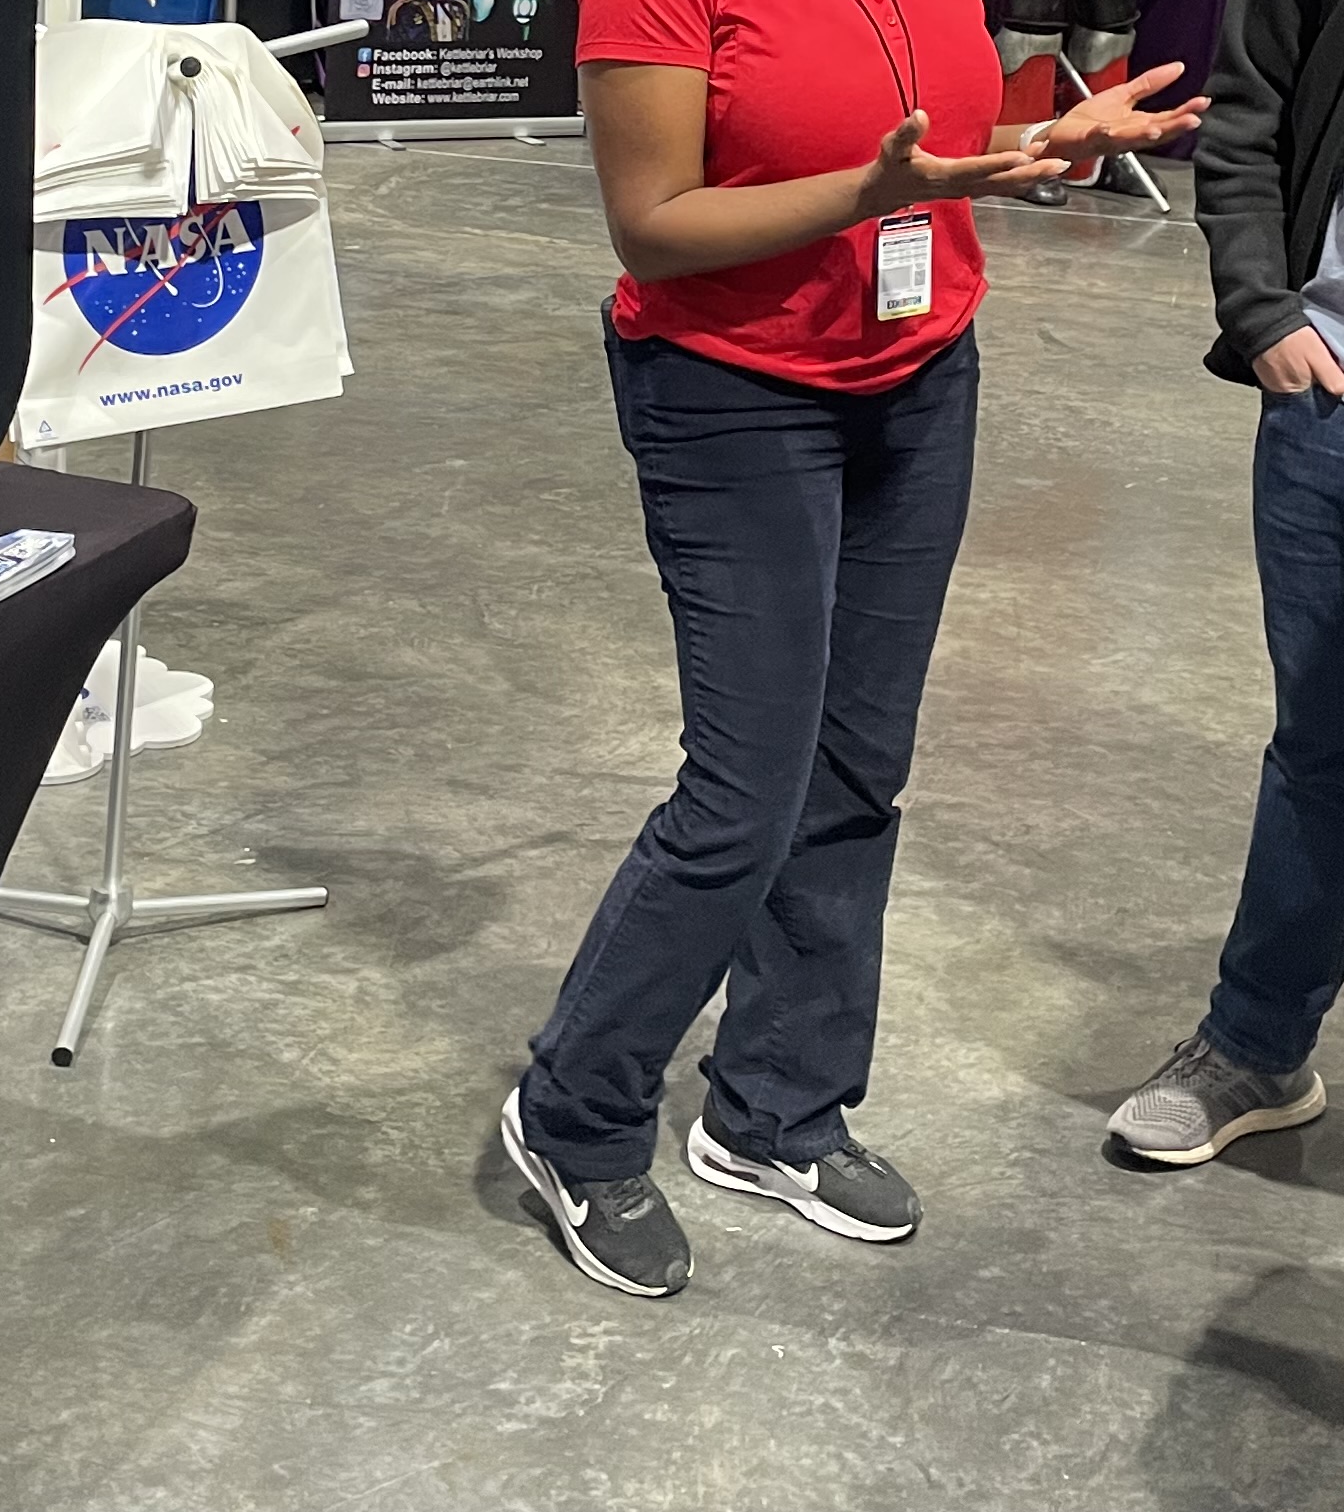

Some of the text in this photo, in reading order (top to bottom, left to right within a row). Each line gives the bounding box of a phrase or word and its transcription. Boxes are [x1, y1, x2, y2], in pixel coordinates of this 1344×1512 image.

[373, 48, 438, 61] Facebook:
[372, 63, 439, 77] Instagram:
[372, 78, 416, 90] E-mail:
[371, 92, 426, 105] Website:
[83, 208, 257, 278] NASA
[99, 373, 244, 406] www.nasa.gov
